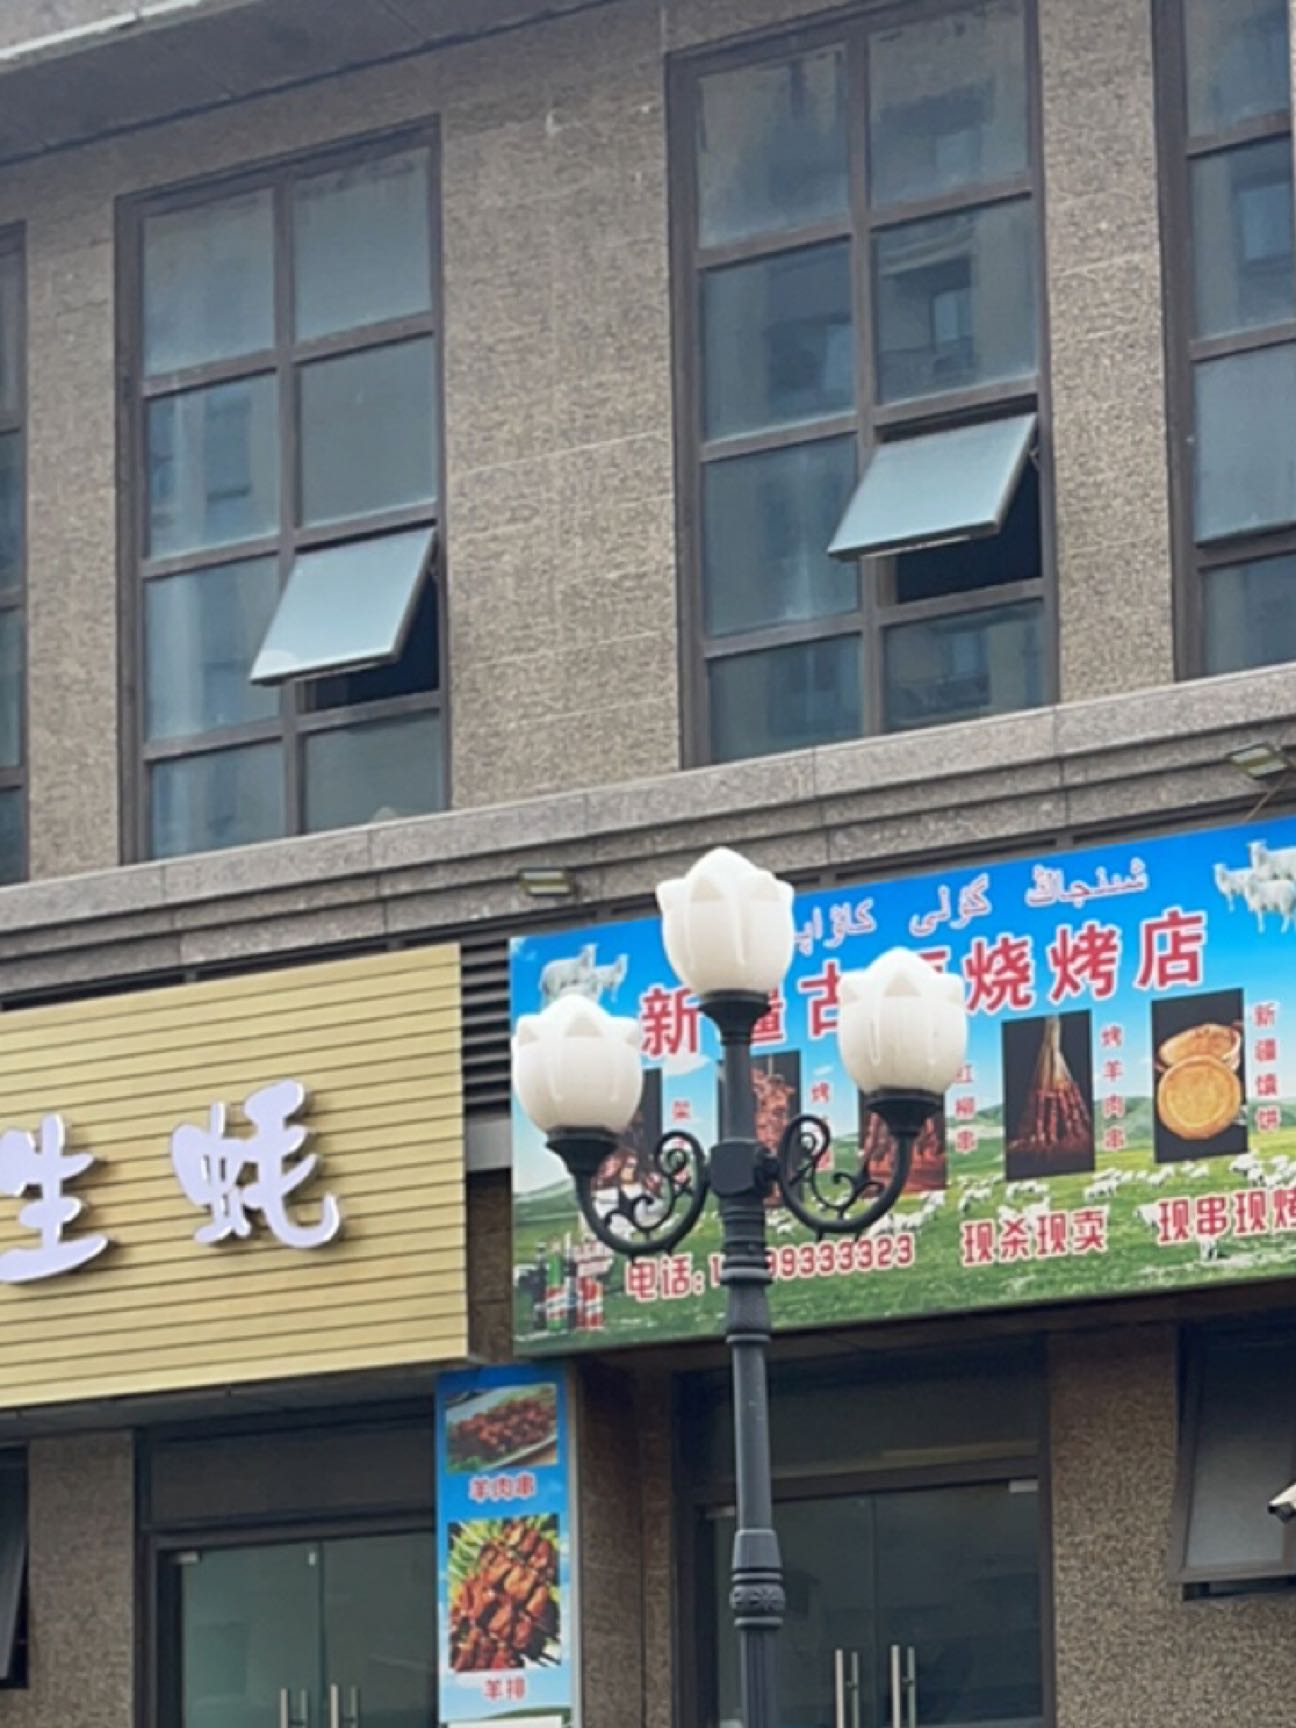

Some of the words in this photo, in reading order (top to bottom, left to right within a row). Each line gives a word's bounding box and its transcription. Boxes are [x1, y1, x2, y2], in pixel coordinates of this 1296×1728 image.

[640, 910, 1203, 1057] 新古烧烤店
[963, 1208, 1105, 1264] 现杀现卖
